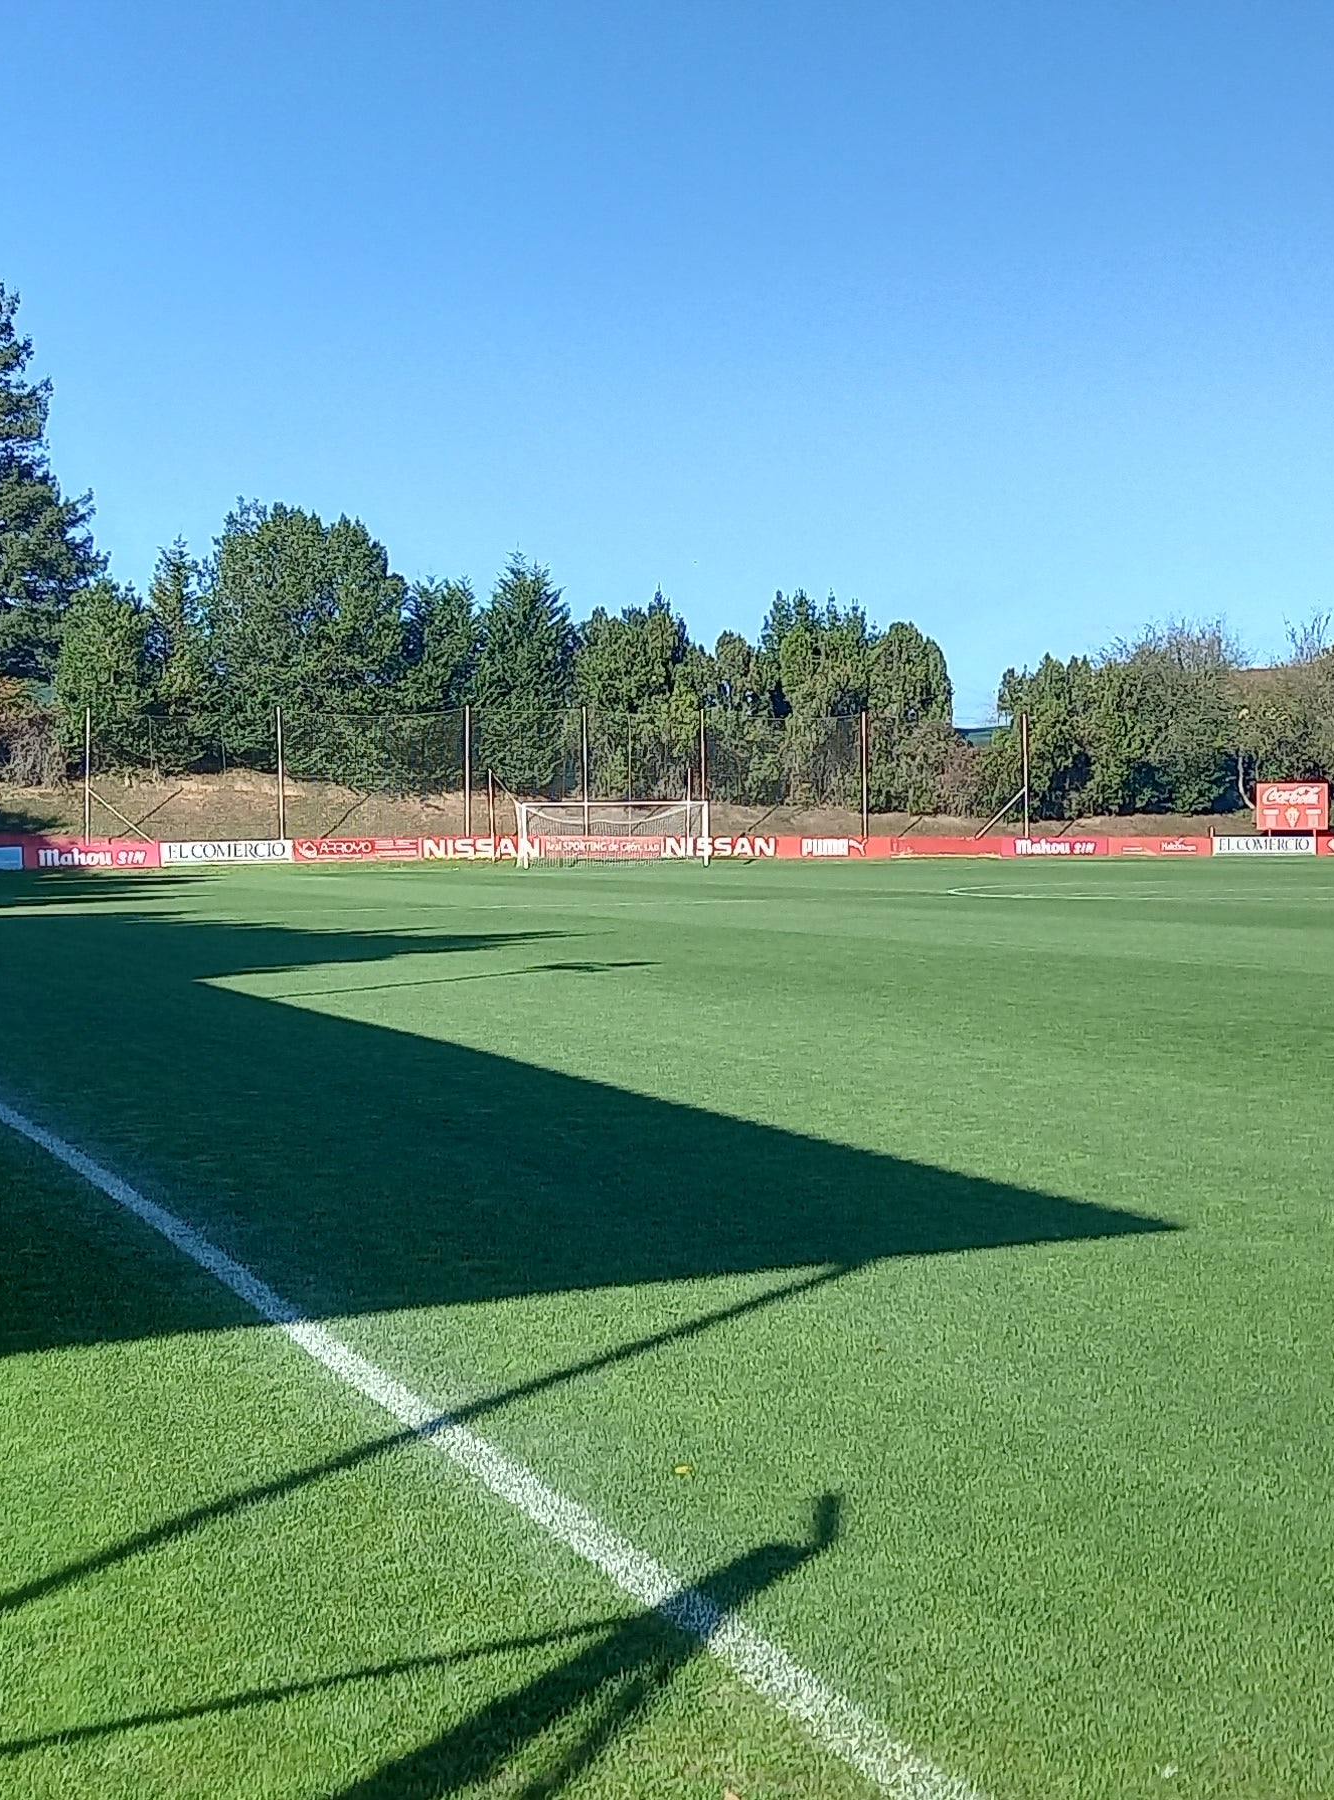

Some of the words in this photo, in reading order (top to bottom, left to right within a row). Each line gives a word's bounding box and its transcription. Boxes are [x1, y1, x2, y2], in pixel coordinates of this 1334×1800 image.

[169, 844, 188, 859] EL
[191, 842, 285, 859] COMERCIO
[320, 841, 372, 853] ARROYO
[424, 838, 539, 858] NISSAN
[666, 837, 775, 857] NISSAN
[801, 838, 849, 856] PUMA
[1015, 839, 1070, 855] Mahou
[1219, 838, 1231, 851] EL
[1237, 838, 1309, 851] COMERCIO
[38, 848, 113, 867] Mahou
[116, 850, 146, 865] SIN
